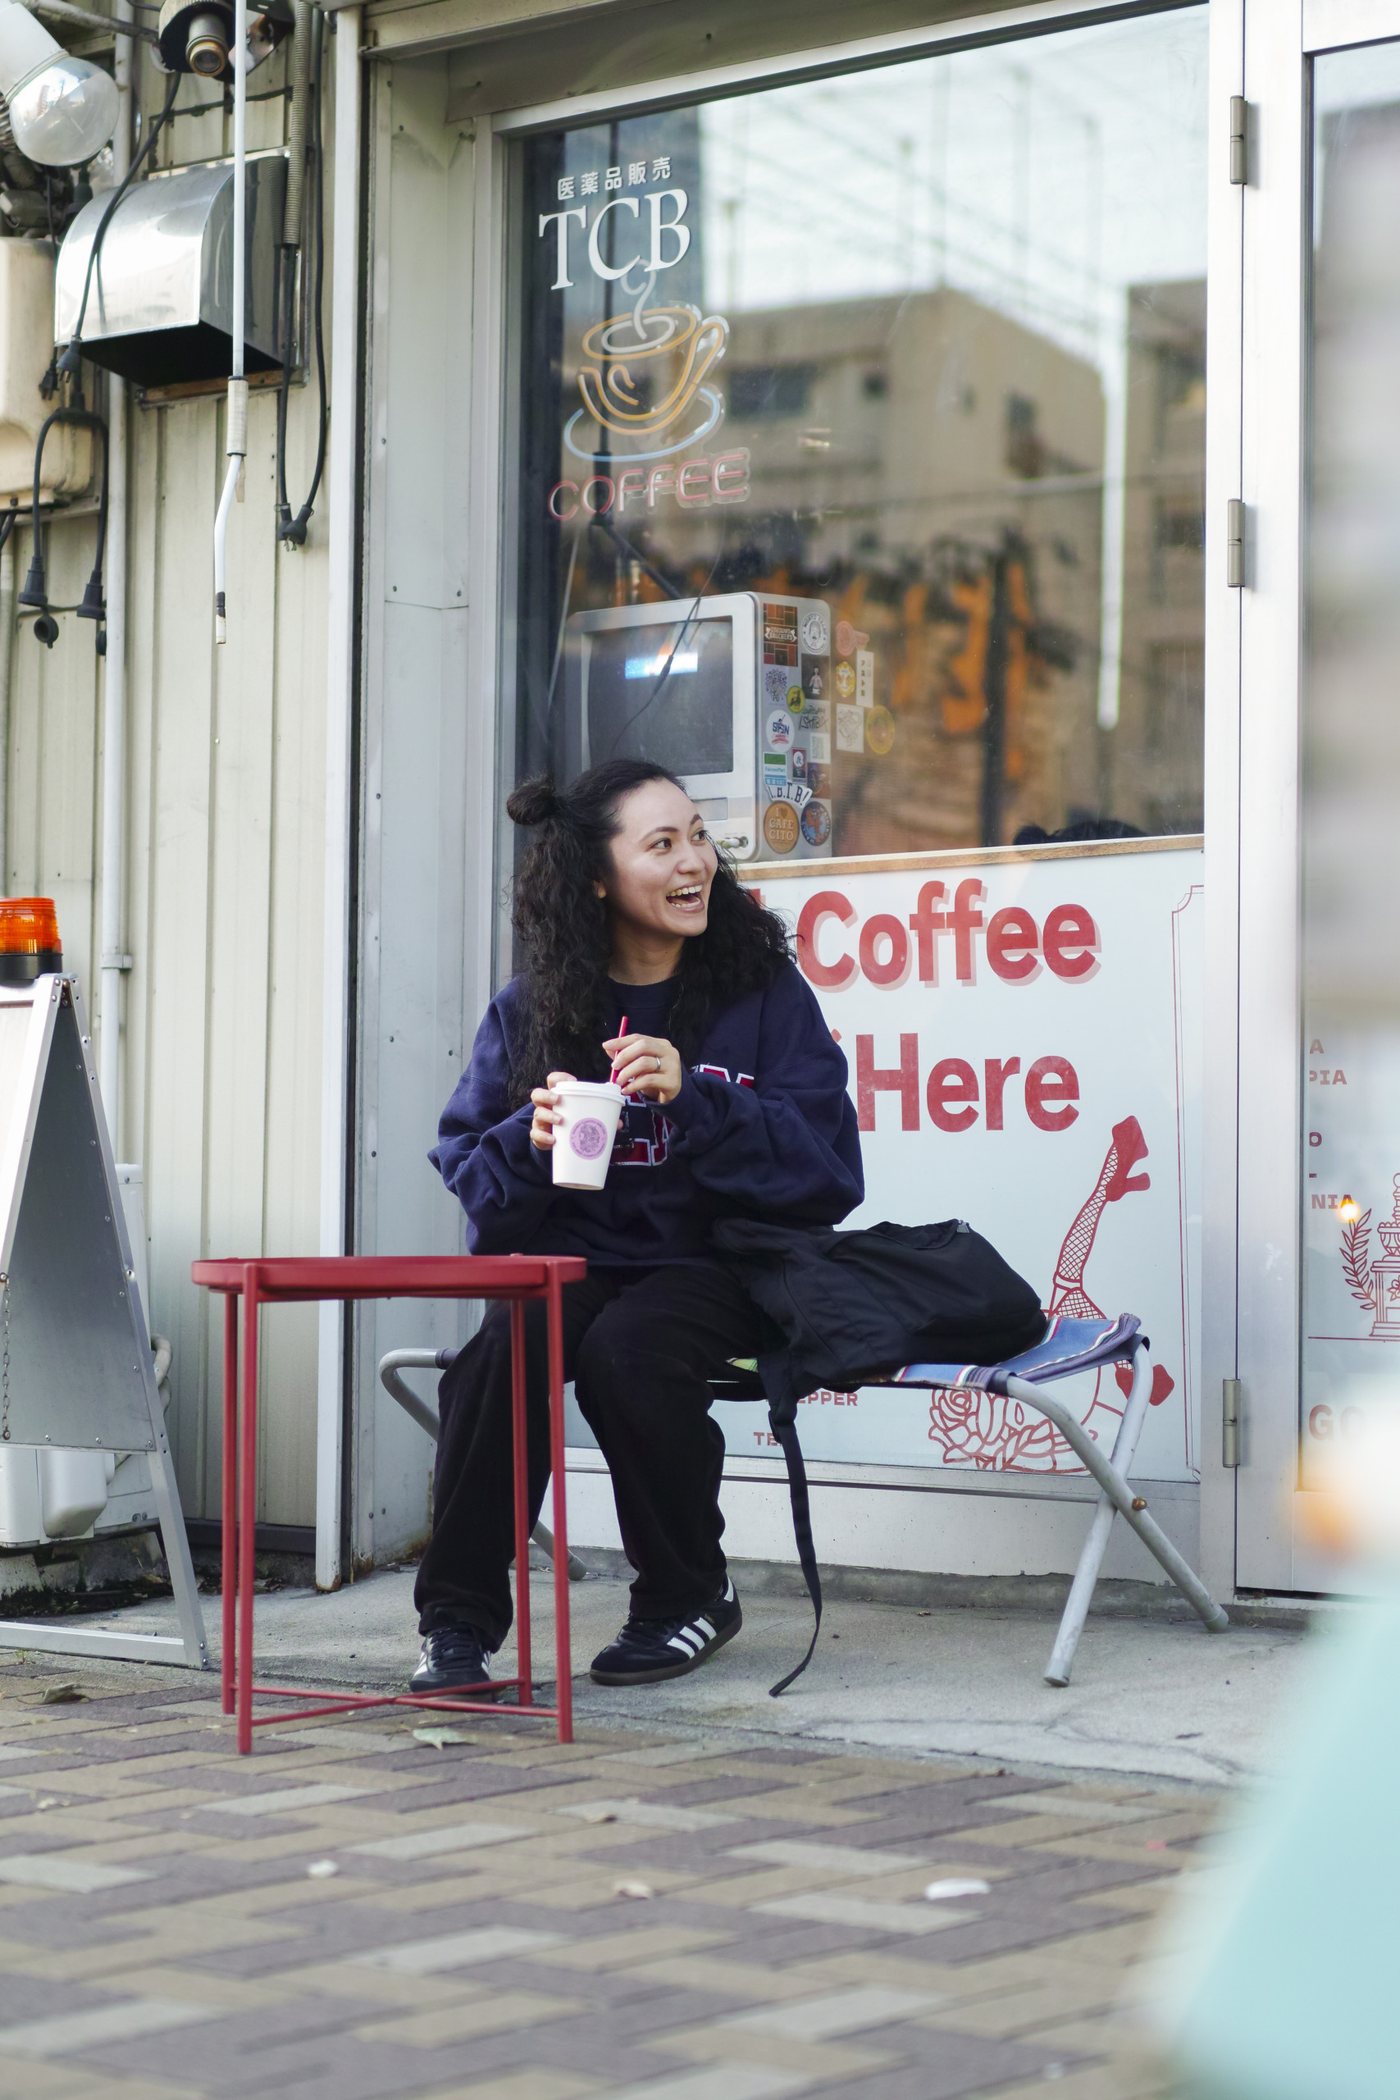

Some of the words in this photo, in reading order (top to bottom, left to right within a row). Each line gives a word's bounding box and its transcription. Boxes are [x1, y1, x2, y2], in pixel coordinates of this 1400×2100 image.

[557, 156, 673, 200] 医薬品販売
[538, 188, 691, 290] TCB
[548, 452, 748, 521] COFFEE
[768, 830, 794, 841] CITO
[797, 878, 1101, 992] Coffee
[855, 1033, 1080, 1132] Here
[753, 1432, 783, 1447] TE
